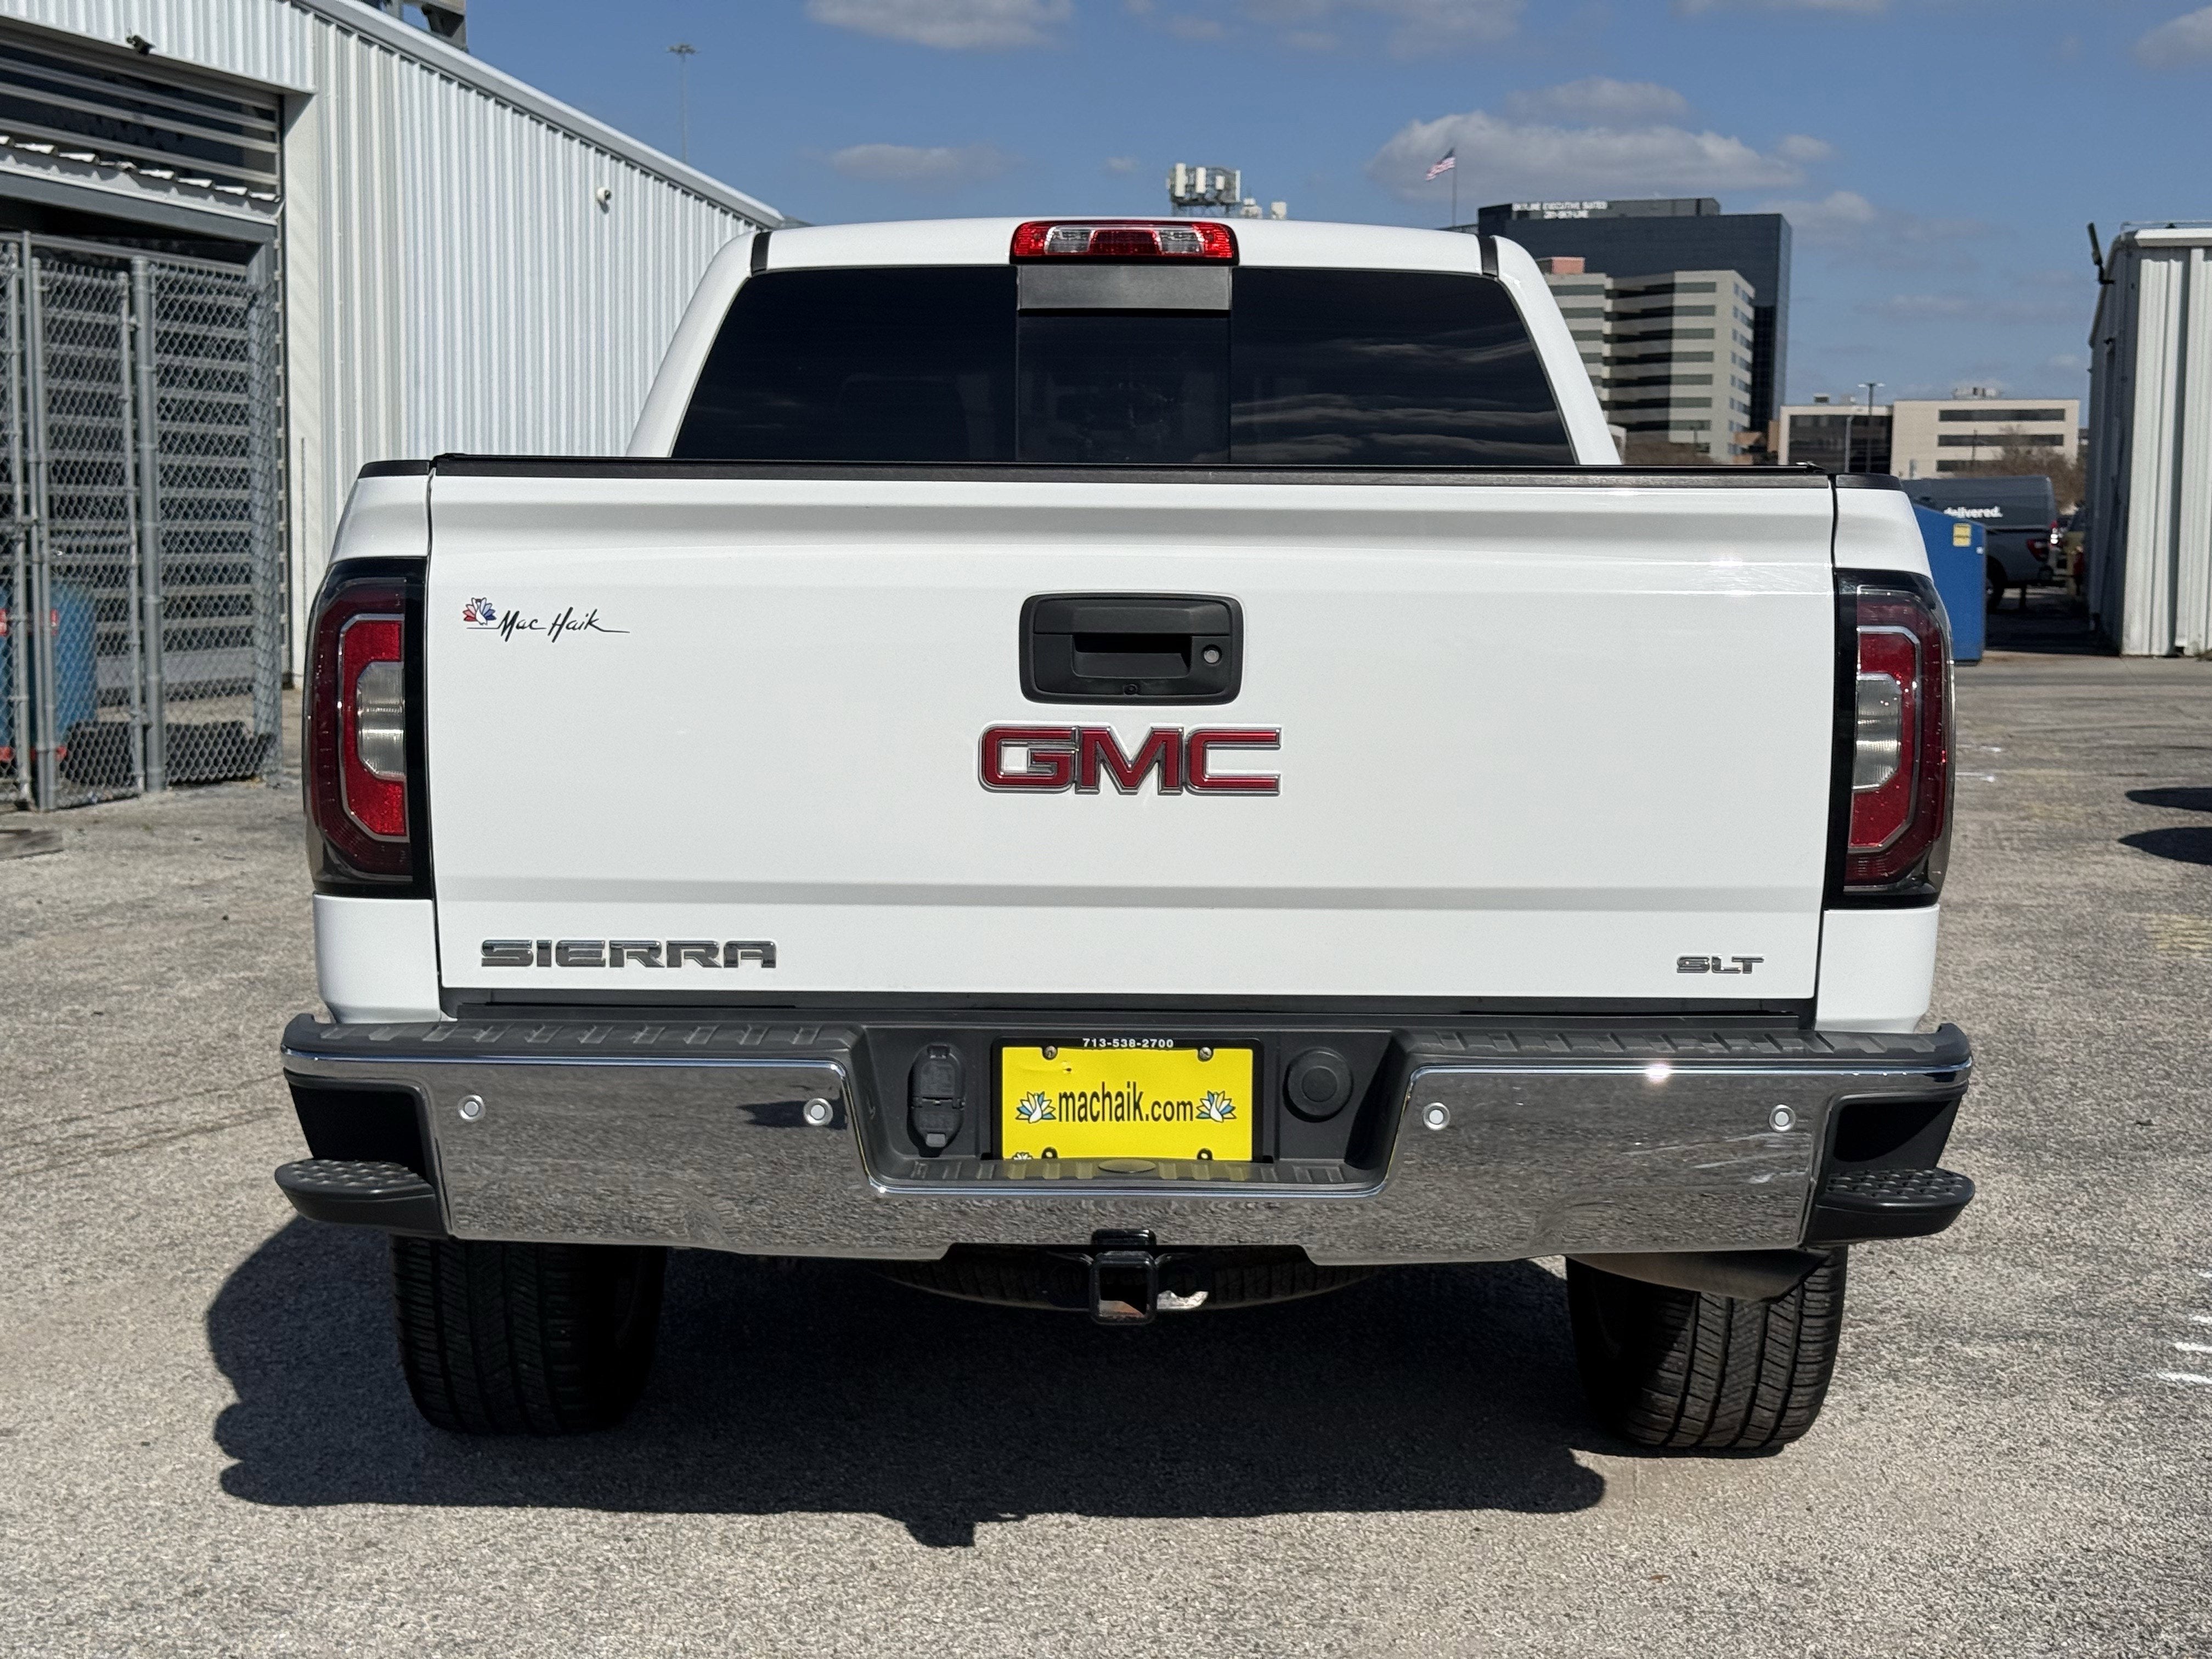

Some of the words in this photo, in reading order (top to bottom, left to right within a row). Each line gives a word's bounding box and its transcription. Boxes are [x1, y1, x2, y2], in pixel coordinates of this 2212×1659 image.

[487, 610, 548, 642] Mac
[547, 606, 630, 643] Haik
[978, 725, 1281, 795] GMC
[481, 939, 777, 969] SIERRA
[1677, 956, 1764, 974] SLT
[1082, 1037, 1174, 1048] 713-538-2700
[1058, 1081, 1194, 1122] machaik.com
